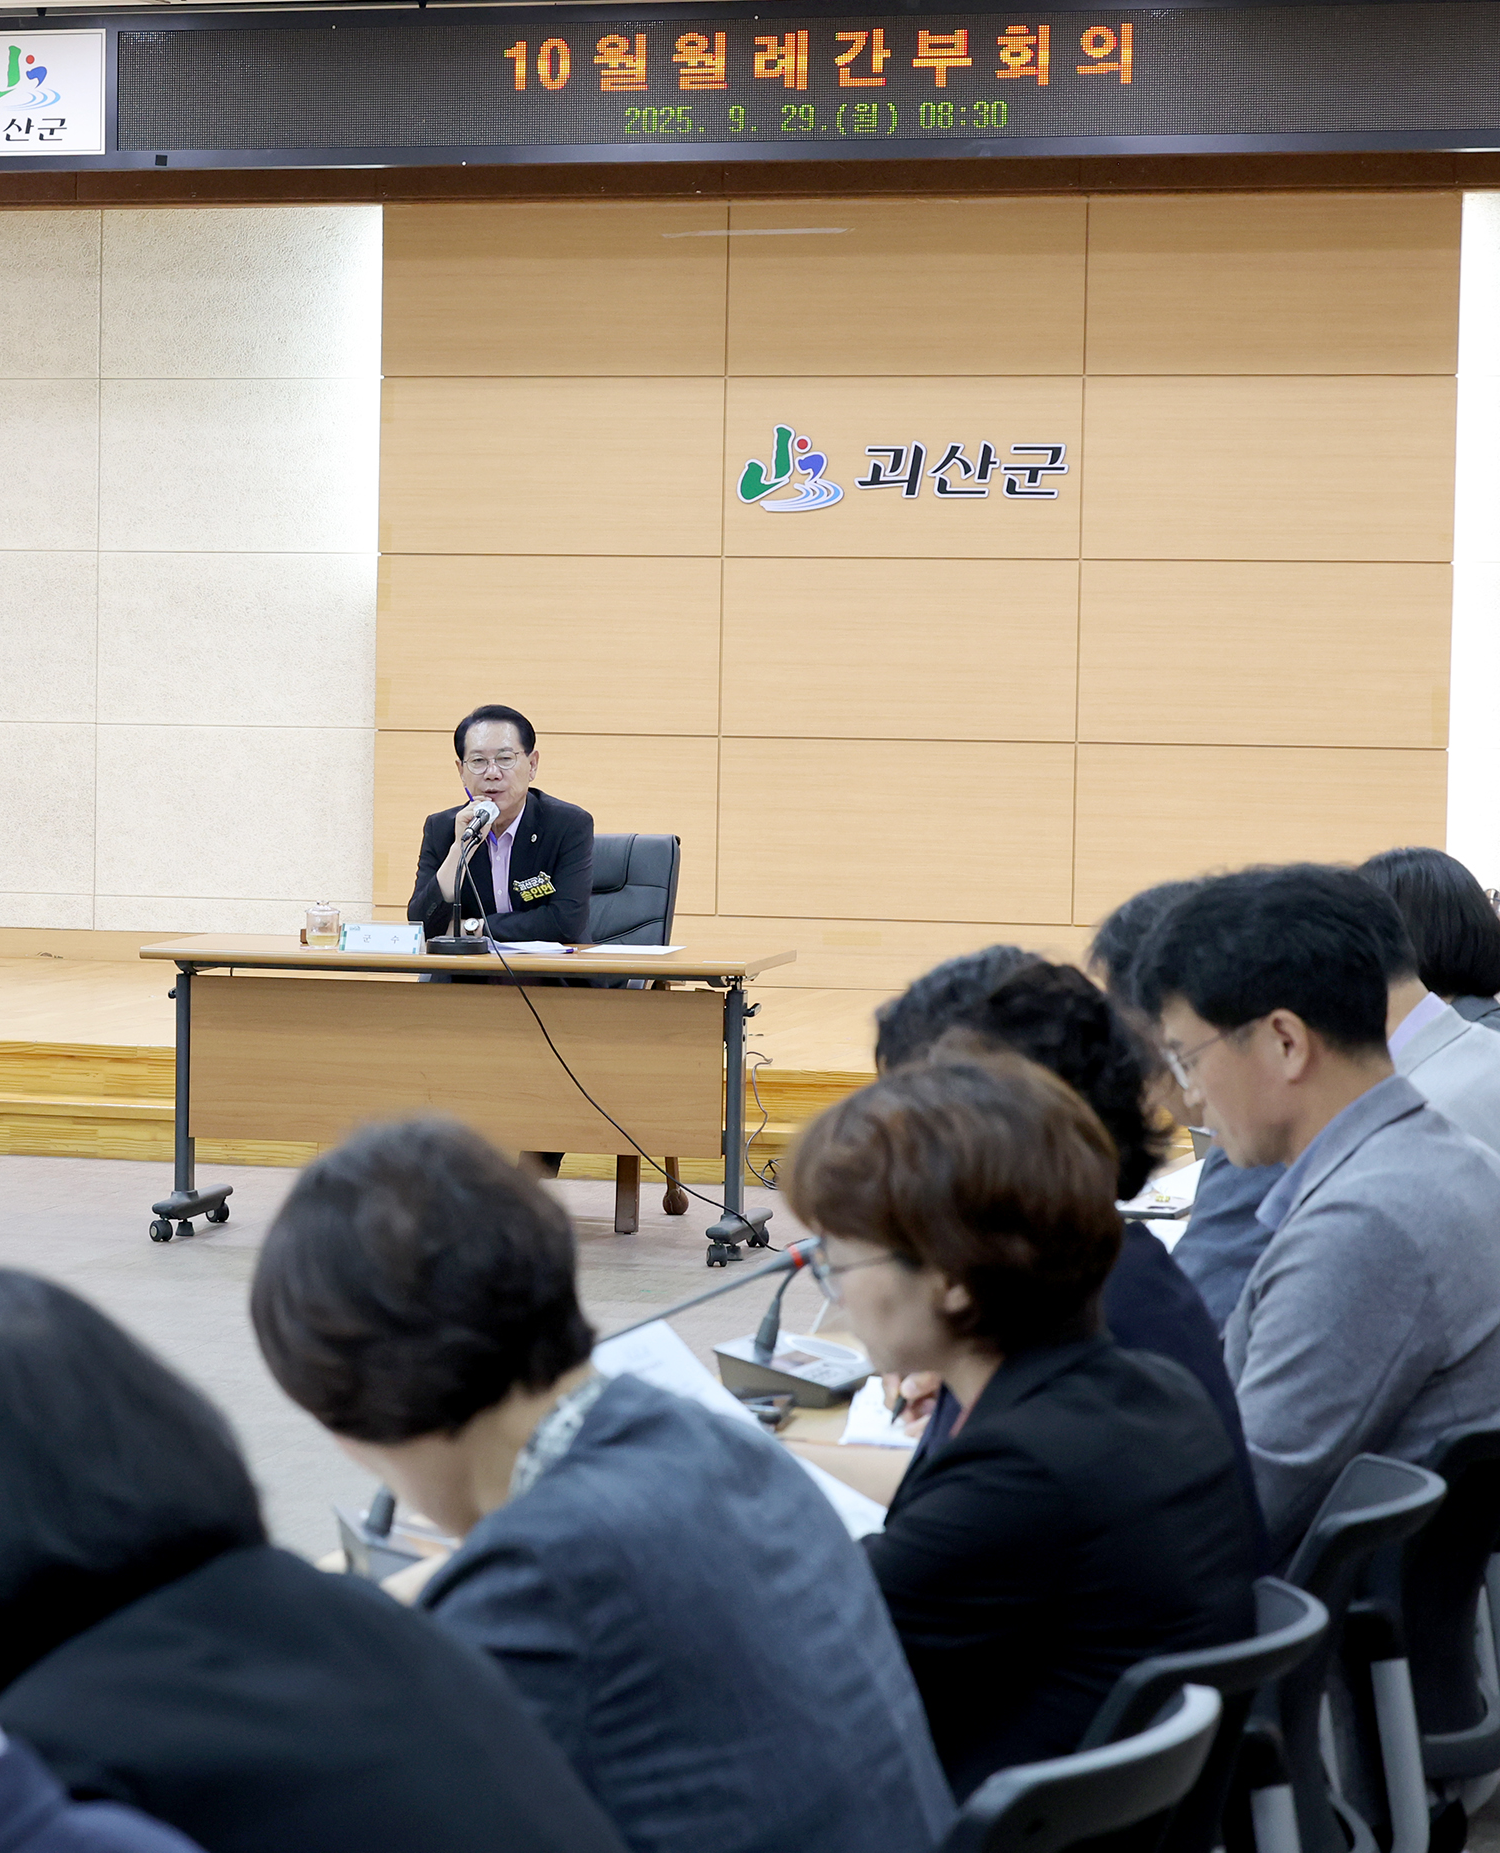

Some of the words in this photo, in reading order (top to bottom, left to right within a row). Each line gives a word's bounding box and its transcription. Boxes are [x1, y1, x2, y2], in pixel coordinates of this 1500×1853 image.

[625, 106, 706, 134] 2025.
[729, 104, 758, 132] 9.
[919, 101, 1008, 129] 08:30
[855, 441, 1069, 498] 괴산군
[520, 882, 556, 902] 송인헌
